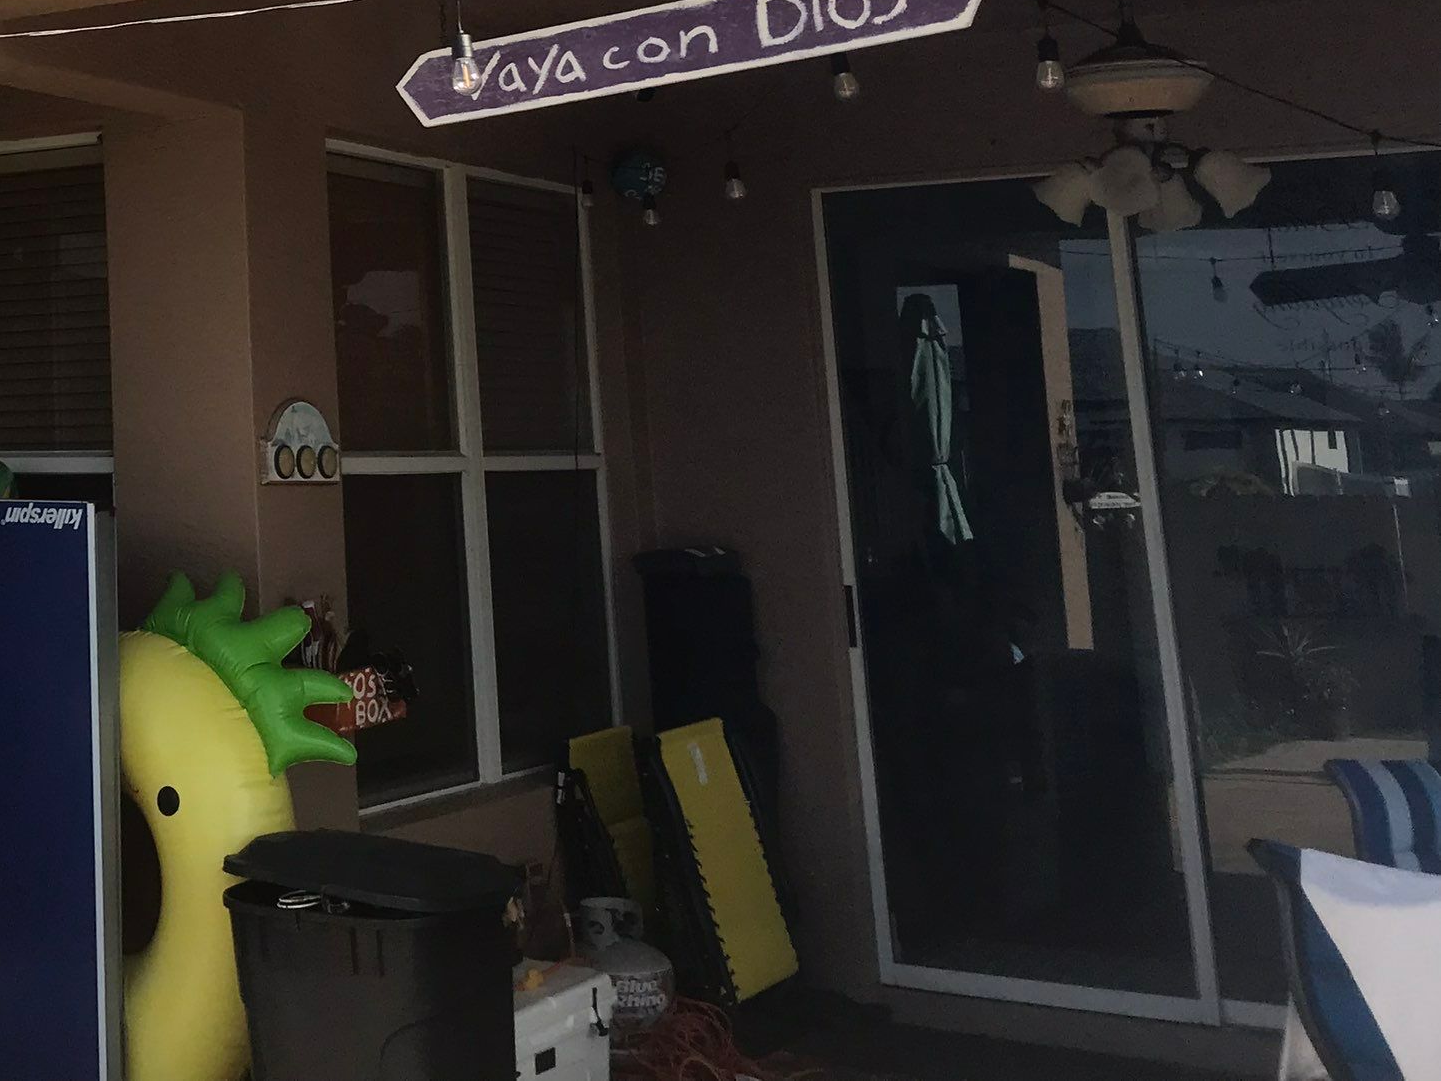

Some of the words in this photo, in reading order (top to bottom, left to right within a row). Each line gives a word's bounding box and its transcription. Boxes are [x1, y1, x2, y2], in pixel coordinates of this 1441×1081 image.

[602, 24, 719, 70] con
[4, 502, 83, 530] killerspin
[355, 698, 393, 726] BOX
